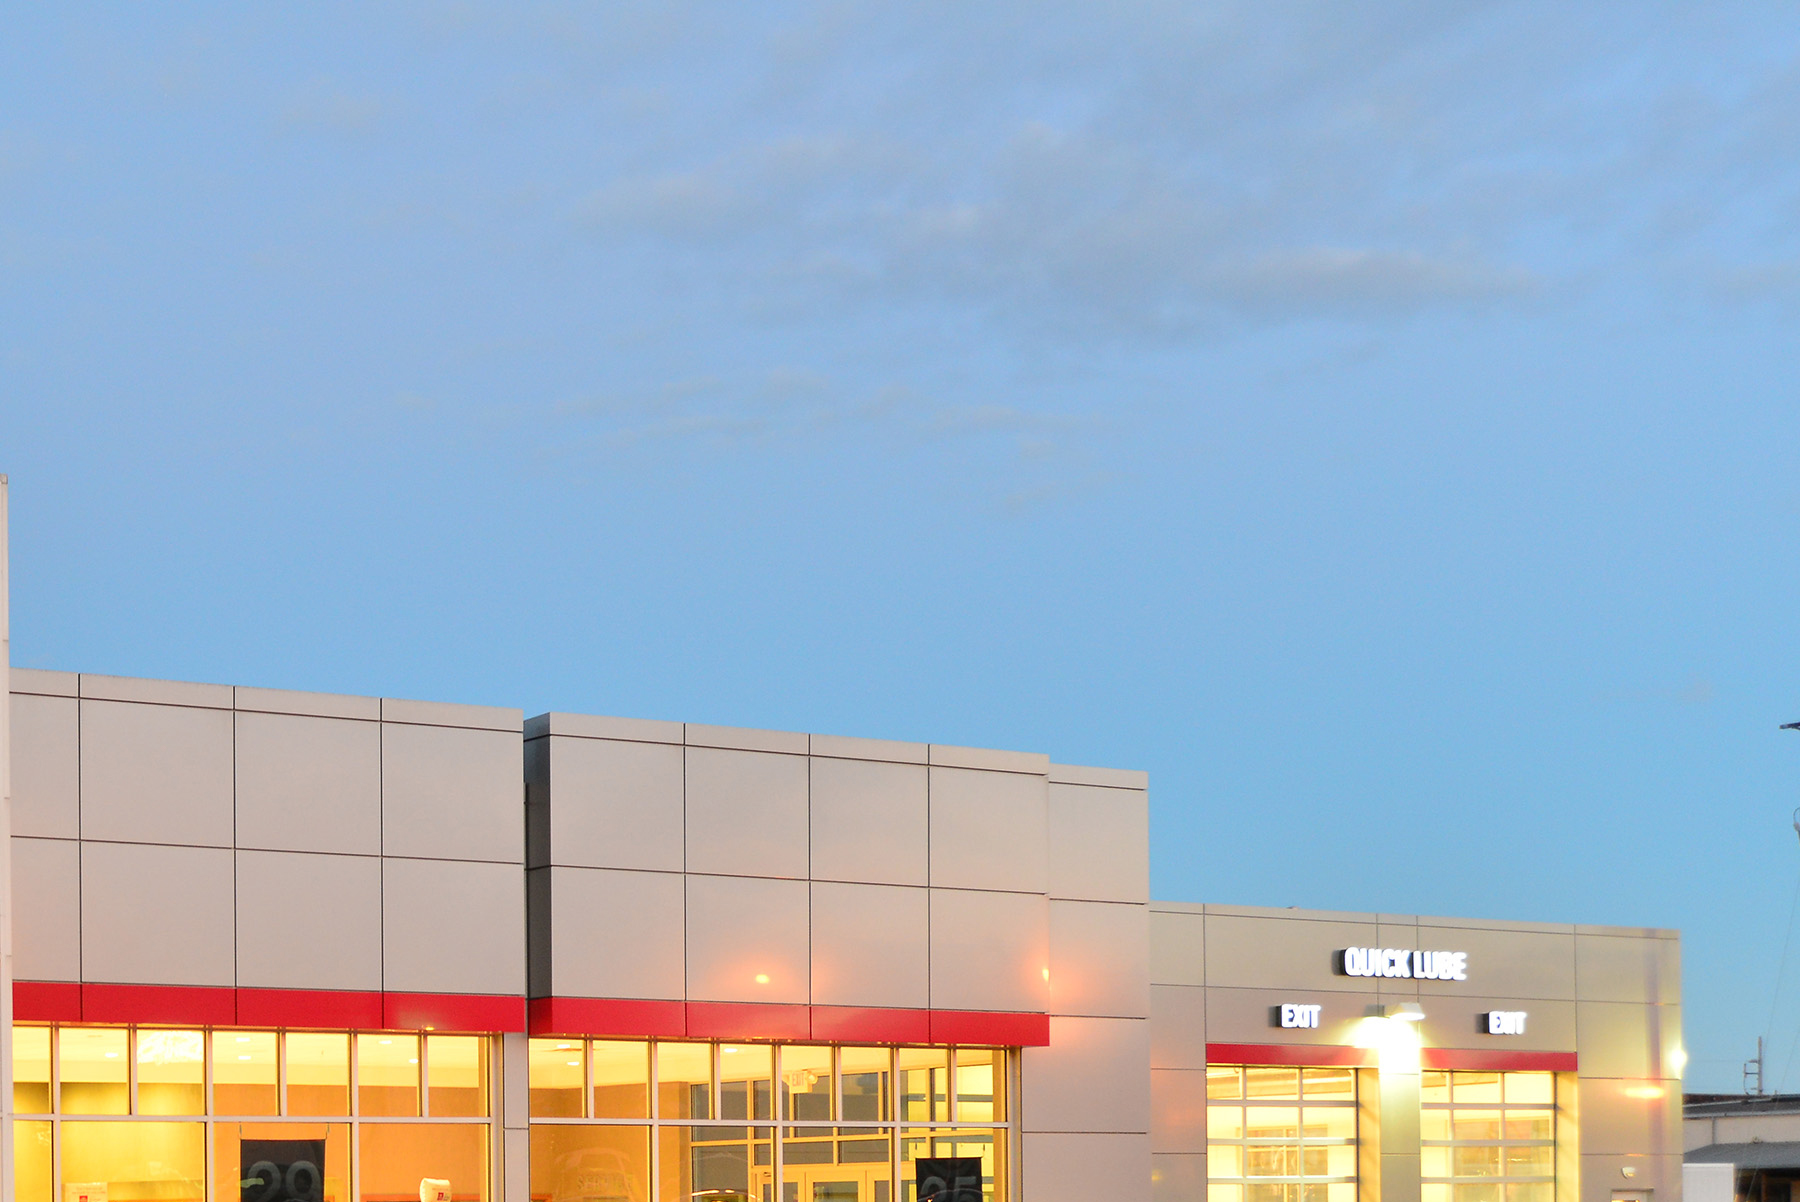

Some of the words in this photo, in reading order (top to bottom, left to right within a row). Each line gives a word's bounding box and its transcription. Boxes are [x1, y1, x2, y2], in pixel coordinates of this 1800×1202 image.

[1343, 946, 1411, 978] QUICK
[1412, 950, 1467, 980] LUBE
[1279, 1003, 1321, 1029] EXIT
[1487, 1010, 1527, 1035] EXIT
